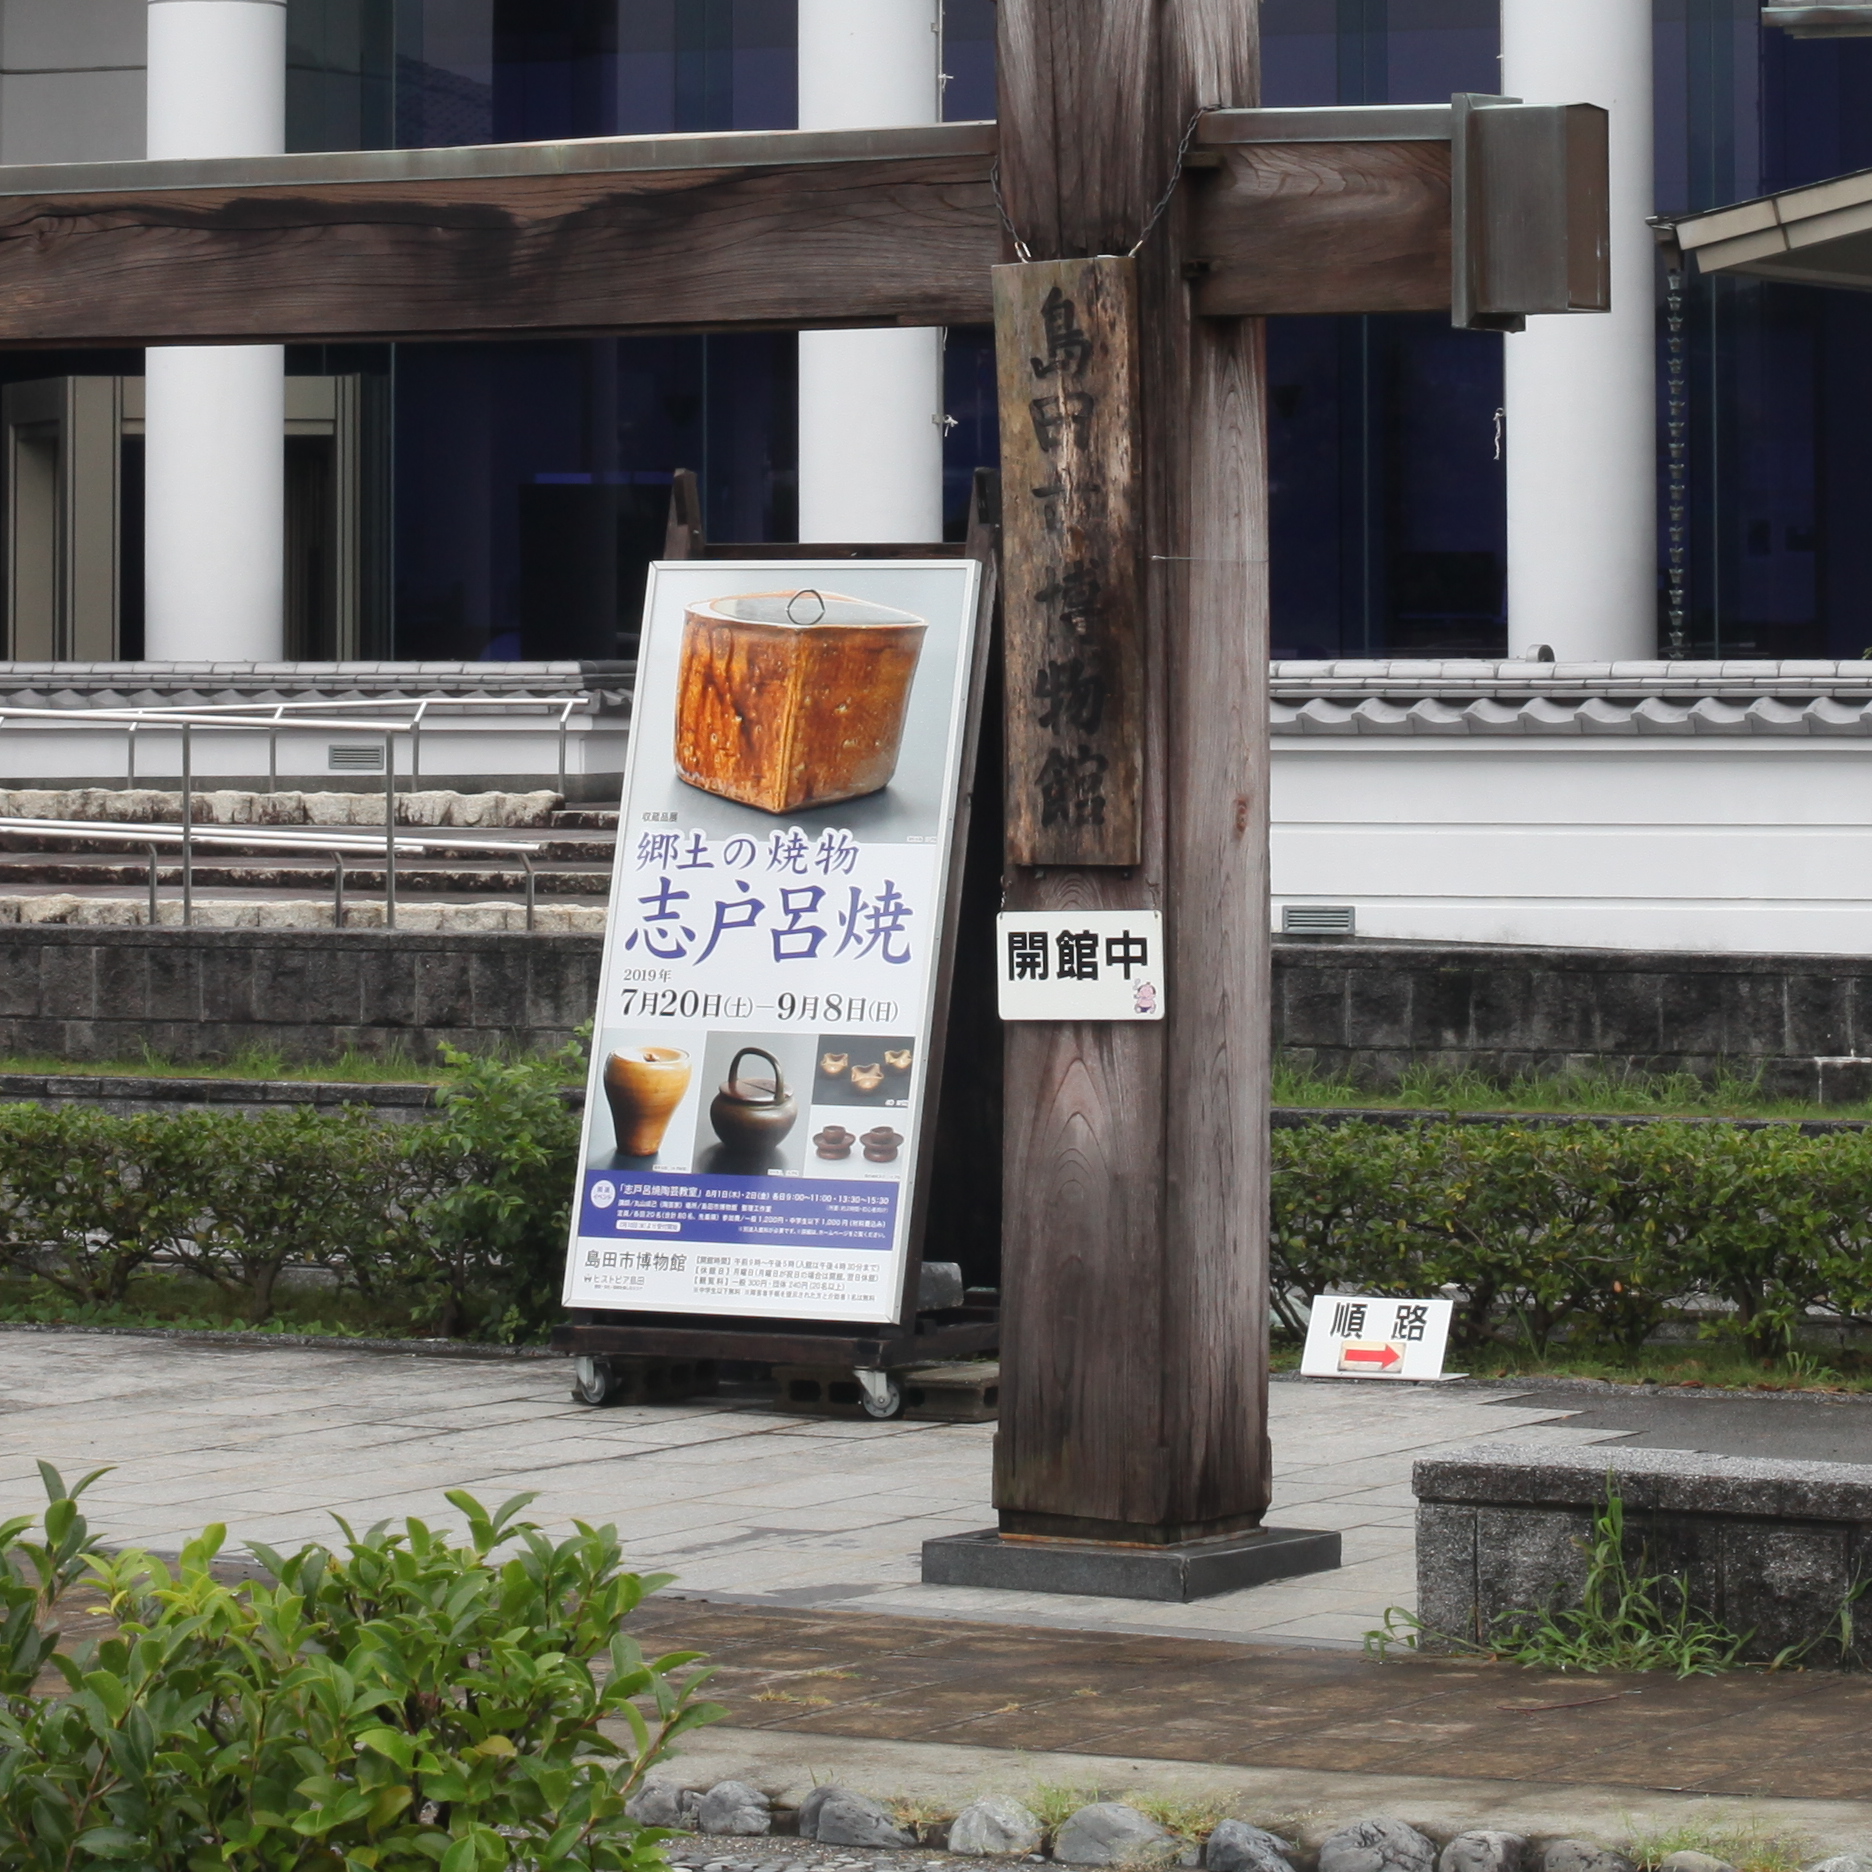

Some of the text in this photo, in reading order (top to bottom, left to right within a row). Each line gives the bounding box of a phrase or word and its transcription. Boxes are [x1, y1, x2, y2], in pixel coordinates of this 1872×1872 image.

[1030, 284, 1112, 831] 島田市博物館
[635, 831, 860, 876] 郷土の焼物
[624, 875, 914, 966] 志戸呂焼
[623, 968, 672, 983] 2019年
[1007, 930, 1149, 982] 開館中
[584, 1249, 688, 1272] 島田市博物館
[1329, 1302, 1429, 1342] 順路
